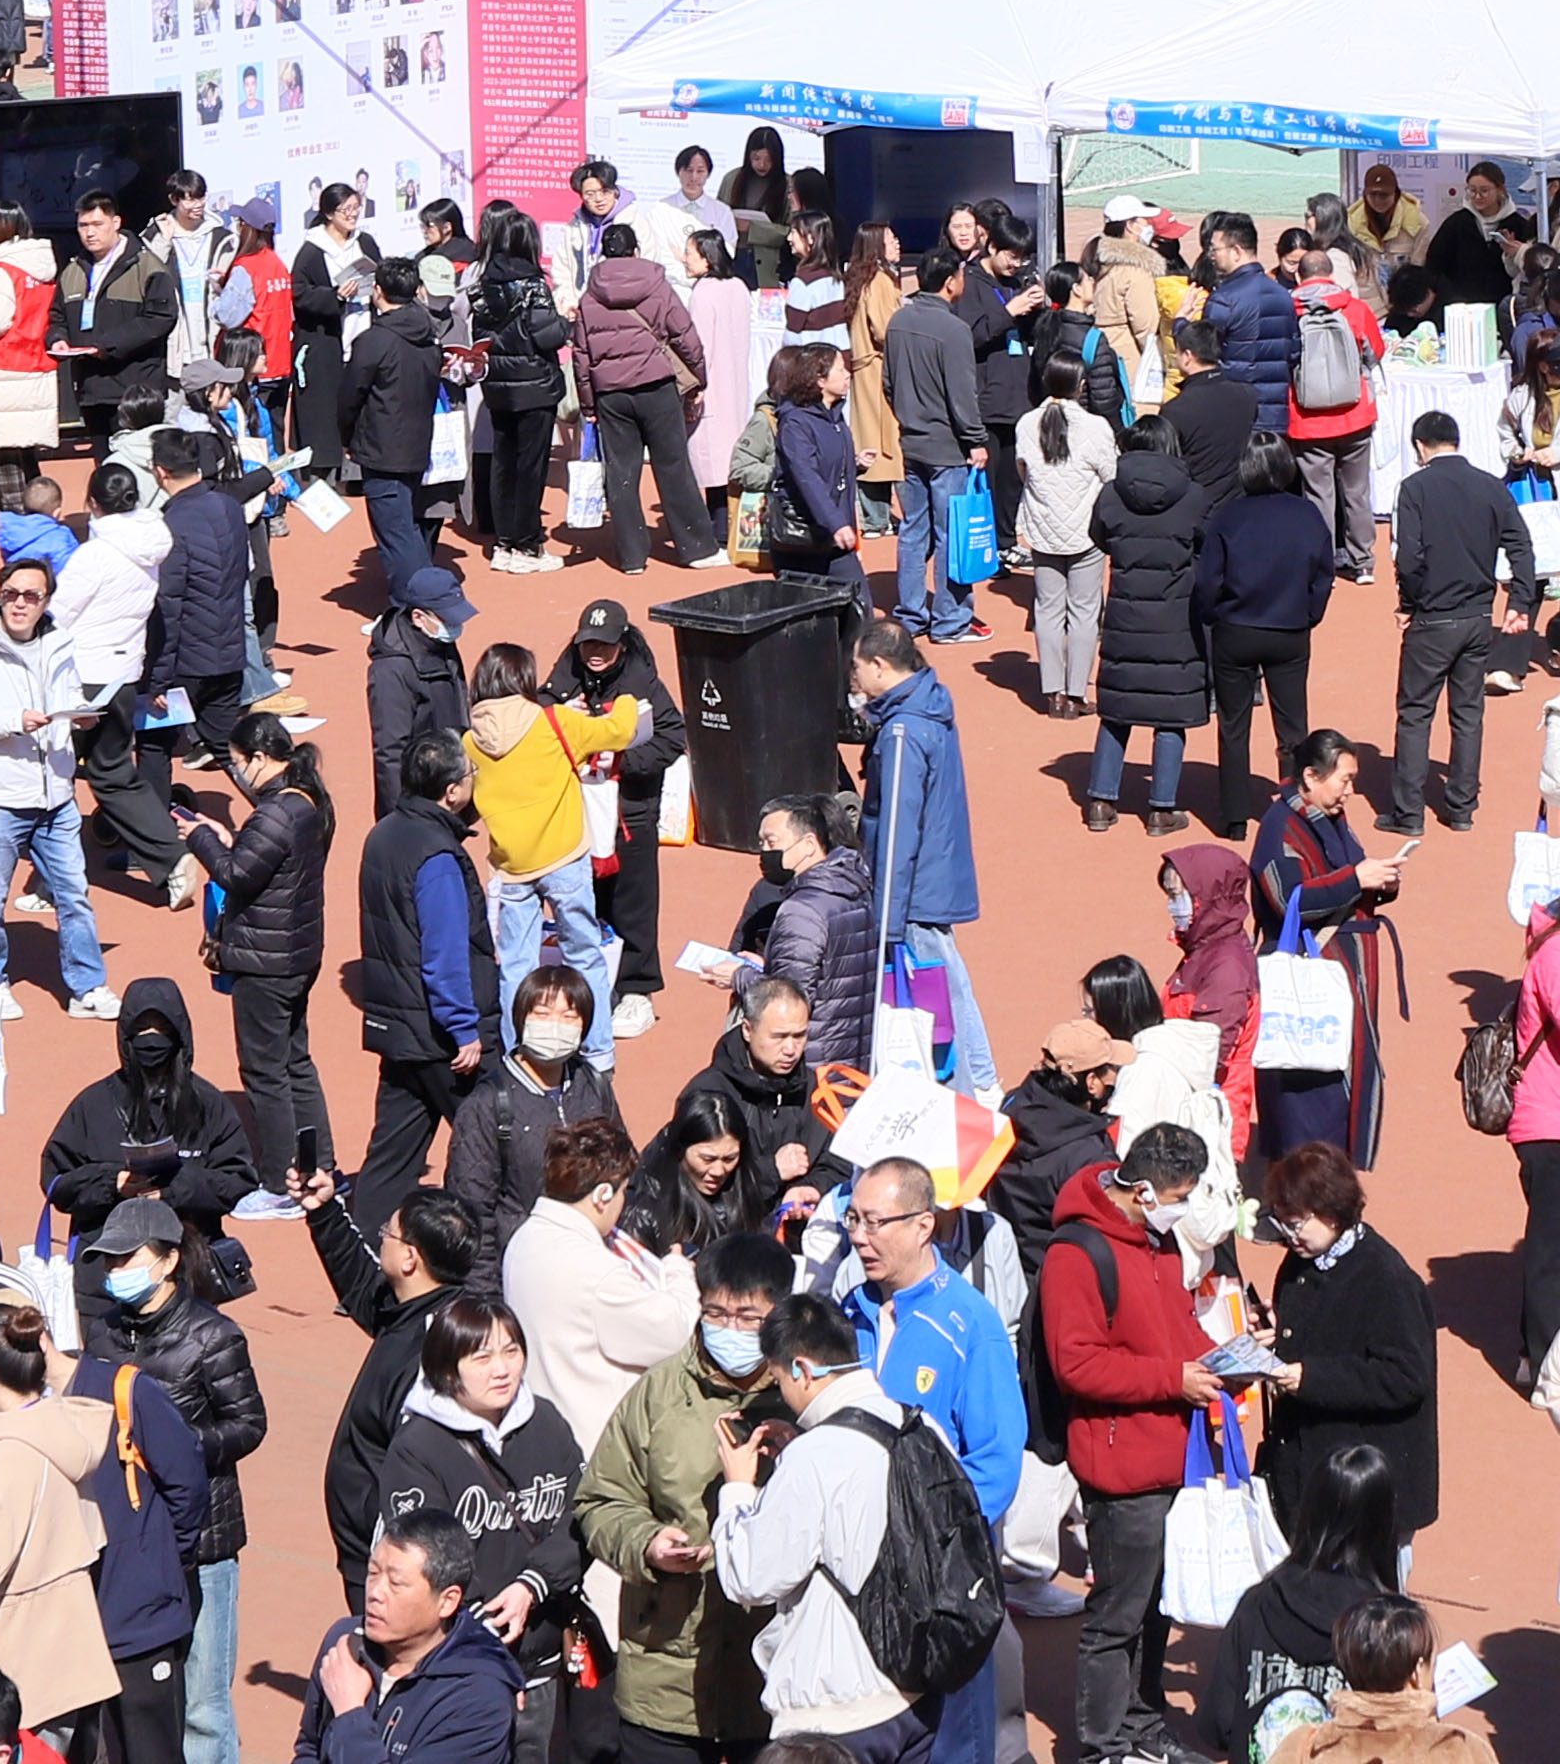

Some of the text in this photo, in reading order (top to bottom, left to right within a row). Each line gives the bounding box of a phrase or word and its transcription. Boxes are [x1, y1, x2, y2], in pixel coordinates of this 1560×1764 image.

[758, 84, 877, 111] 新闻传播学院
[1172, 103, 1362, 134] 印刷与包装工程学院
